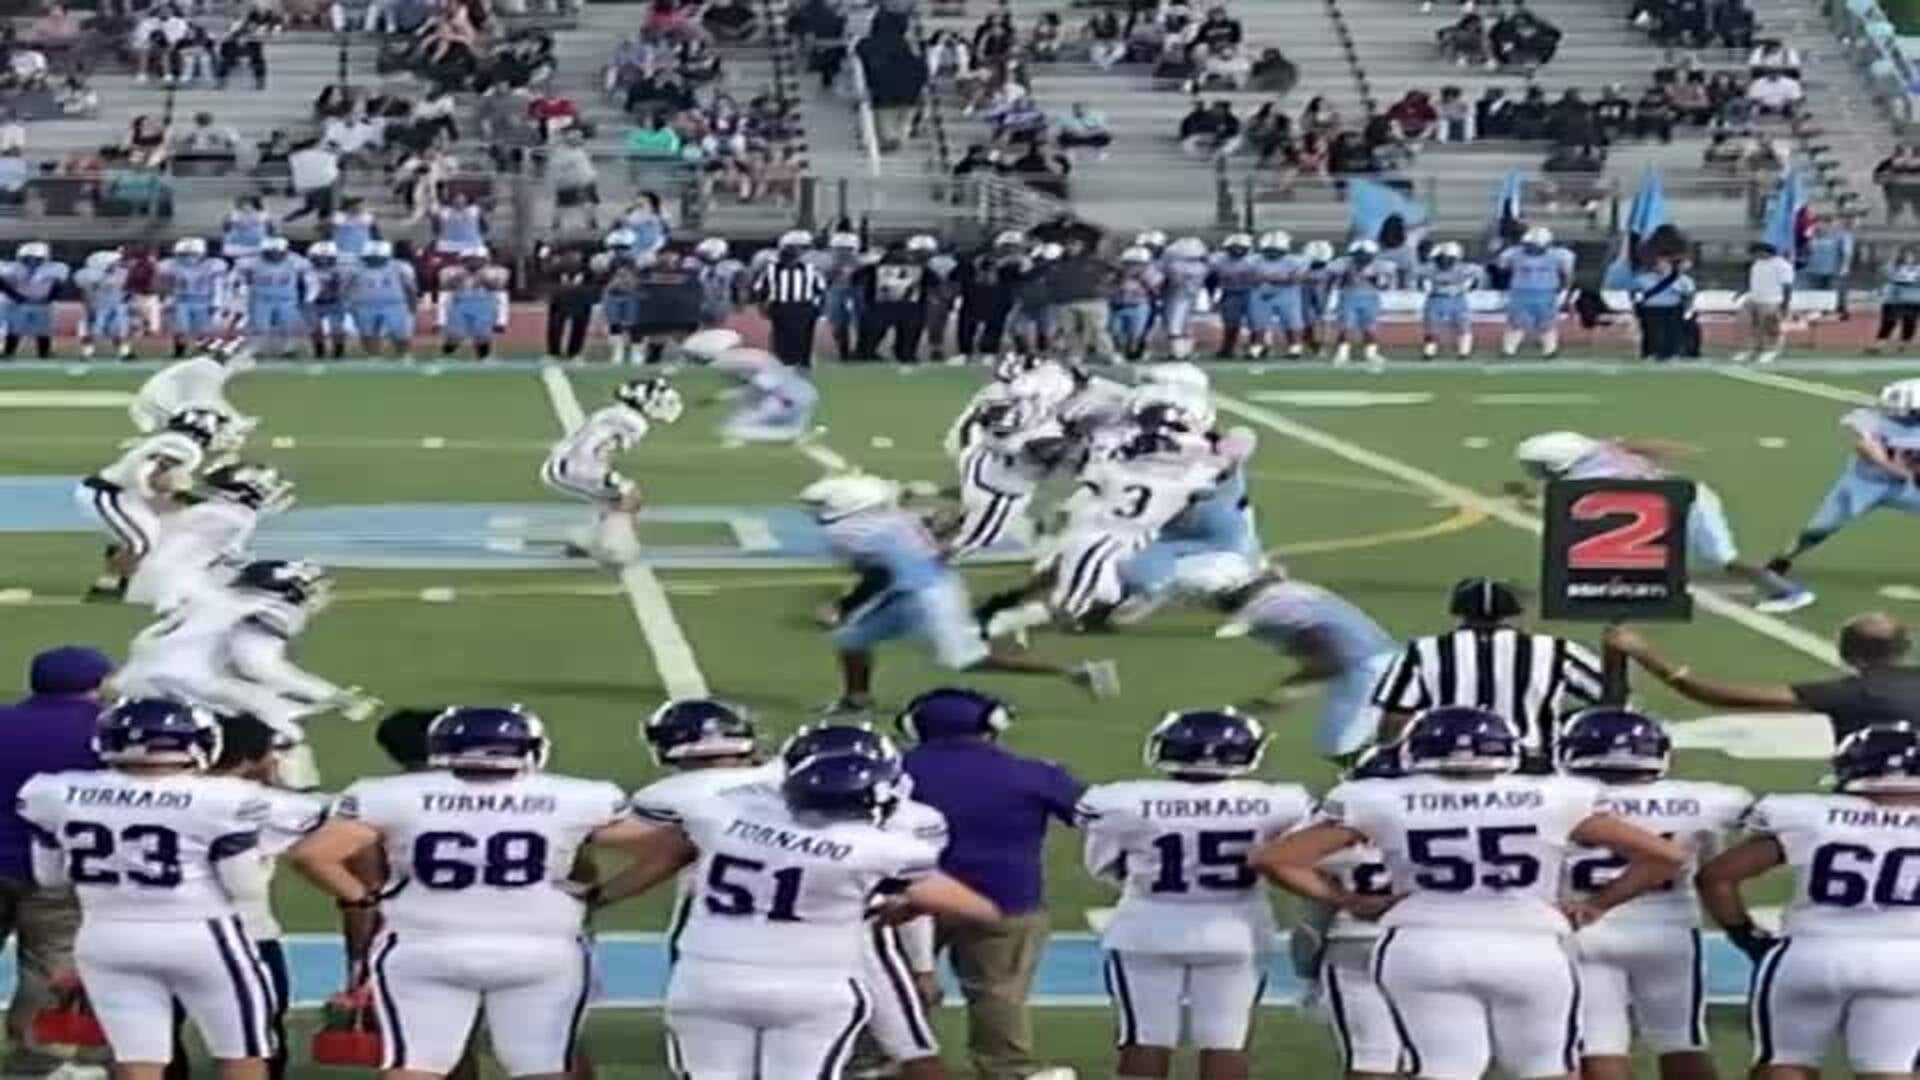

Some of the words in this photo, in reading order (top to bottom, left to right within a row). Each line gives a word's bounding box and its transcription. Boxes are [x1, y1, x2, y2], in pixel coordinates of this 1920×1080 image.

[1567, 491, 1669, 568] 2
[64, 786, 193, 809] TORNADO
[422, 794, 556, 813] TORNADO
[1140, 798, 1270, 818] TORNADO
[1402, 792, 1543, 811] TORNADO
[65, 821, 183, 887] 23
[415, 831, 547, 890] 68
[724, 819, 853, 861] TORNADO
[1152, 830, 1257, 893] 15
[1407, 825, 1541, 893] 55
[706, 853, 806, 921] 51
